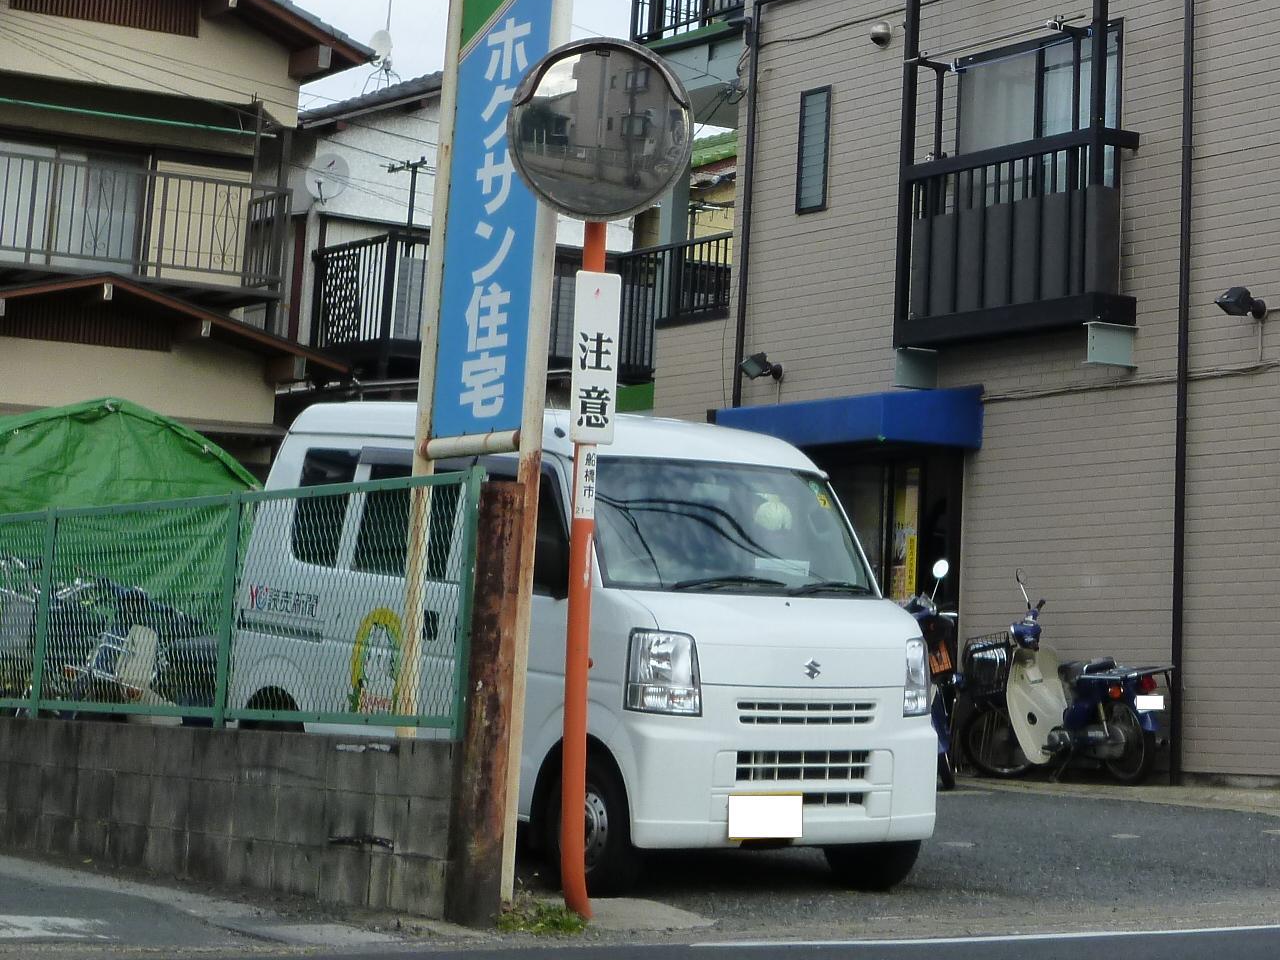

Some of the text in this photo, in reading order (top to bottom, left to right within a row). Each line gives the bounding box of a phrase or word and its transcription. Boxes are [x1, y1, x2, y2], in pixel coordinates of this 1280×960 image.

[460, 17, 532, 418] ホクサン住宅
[577, 332, 613, 428] 注意
[584, 452, 595, 498] 船橋市
[268, 588, 319, 617] 読売新聞
